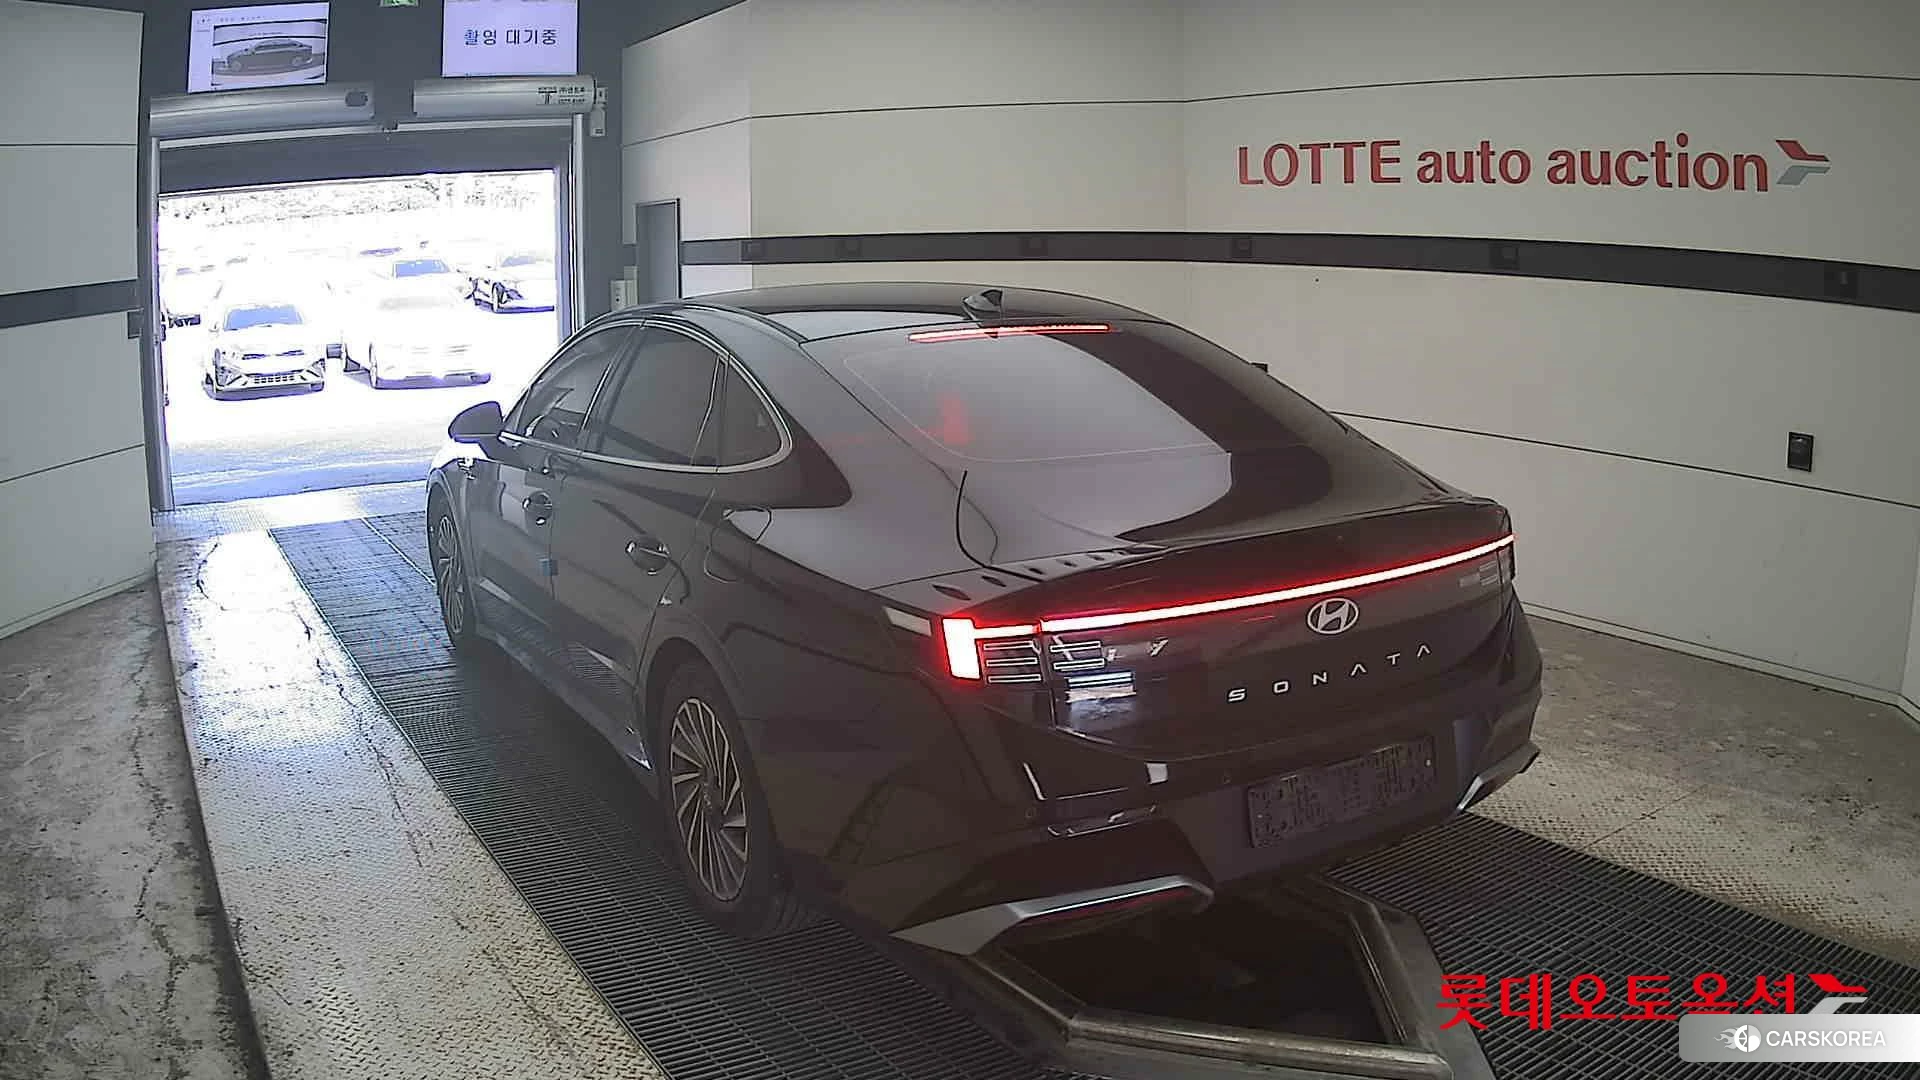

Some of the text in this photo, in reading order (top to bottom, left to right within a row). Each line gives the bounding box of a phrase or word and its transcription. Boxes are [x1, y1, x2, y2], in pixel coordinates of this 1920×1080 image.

[505, 28, 558, 46] 대기중
[1238, 132, 1770, 193] LOTTE auto auction
[1227, 643, 1432, 703] SONATA
